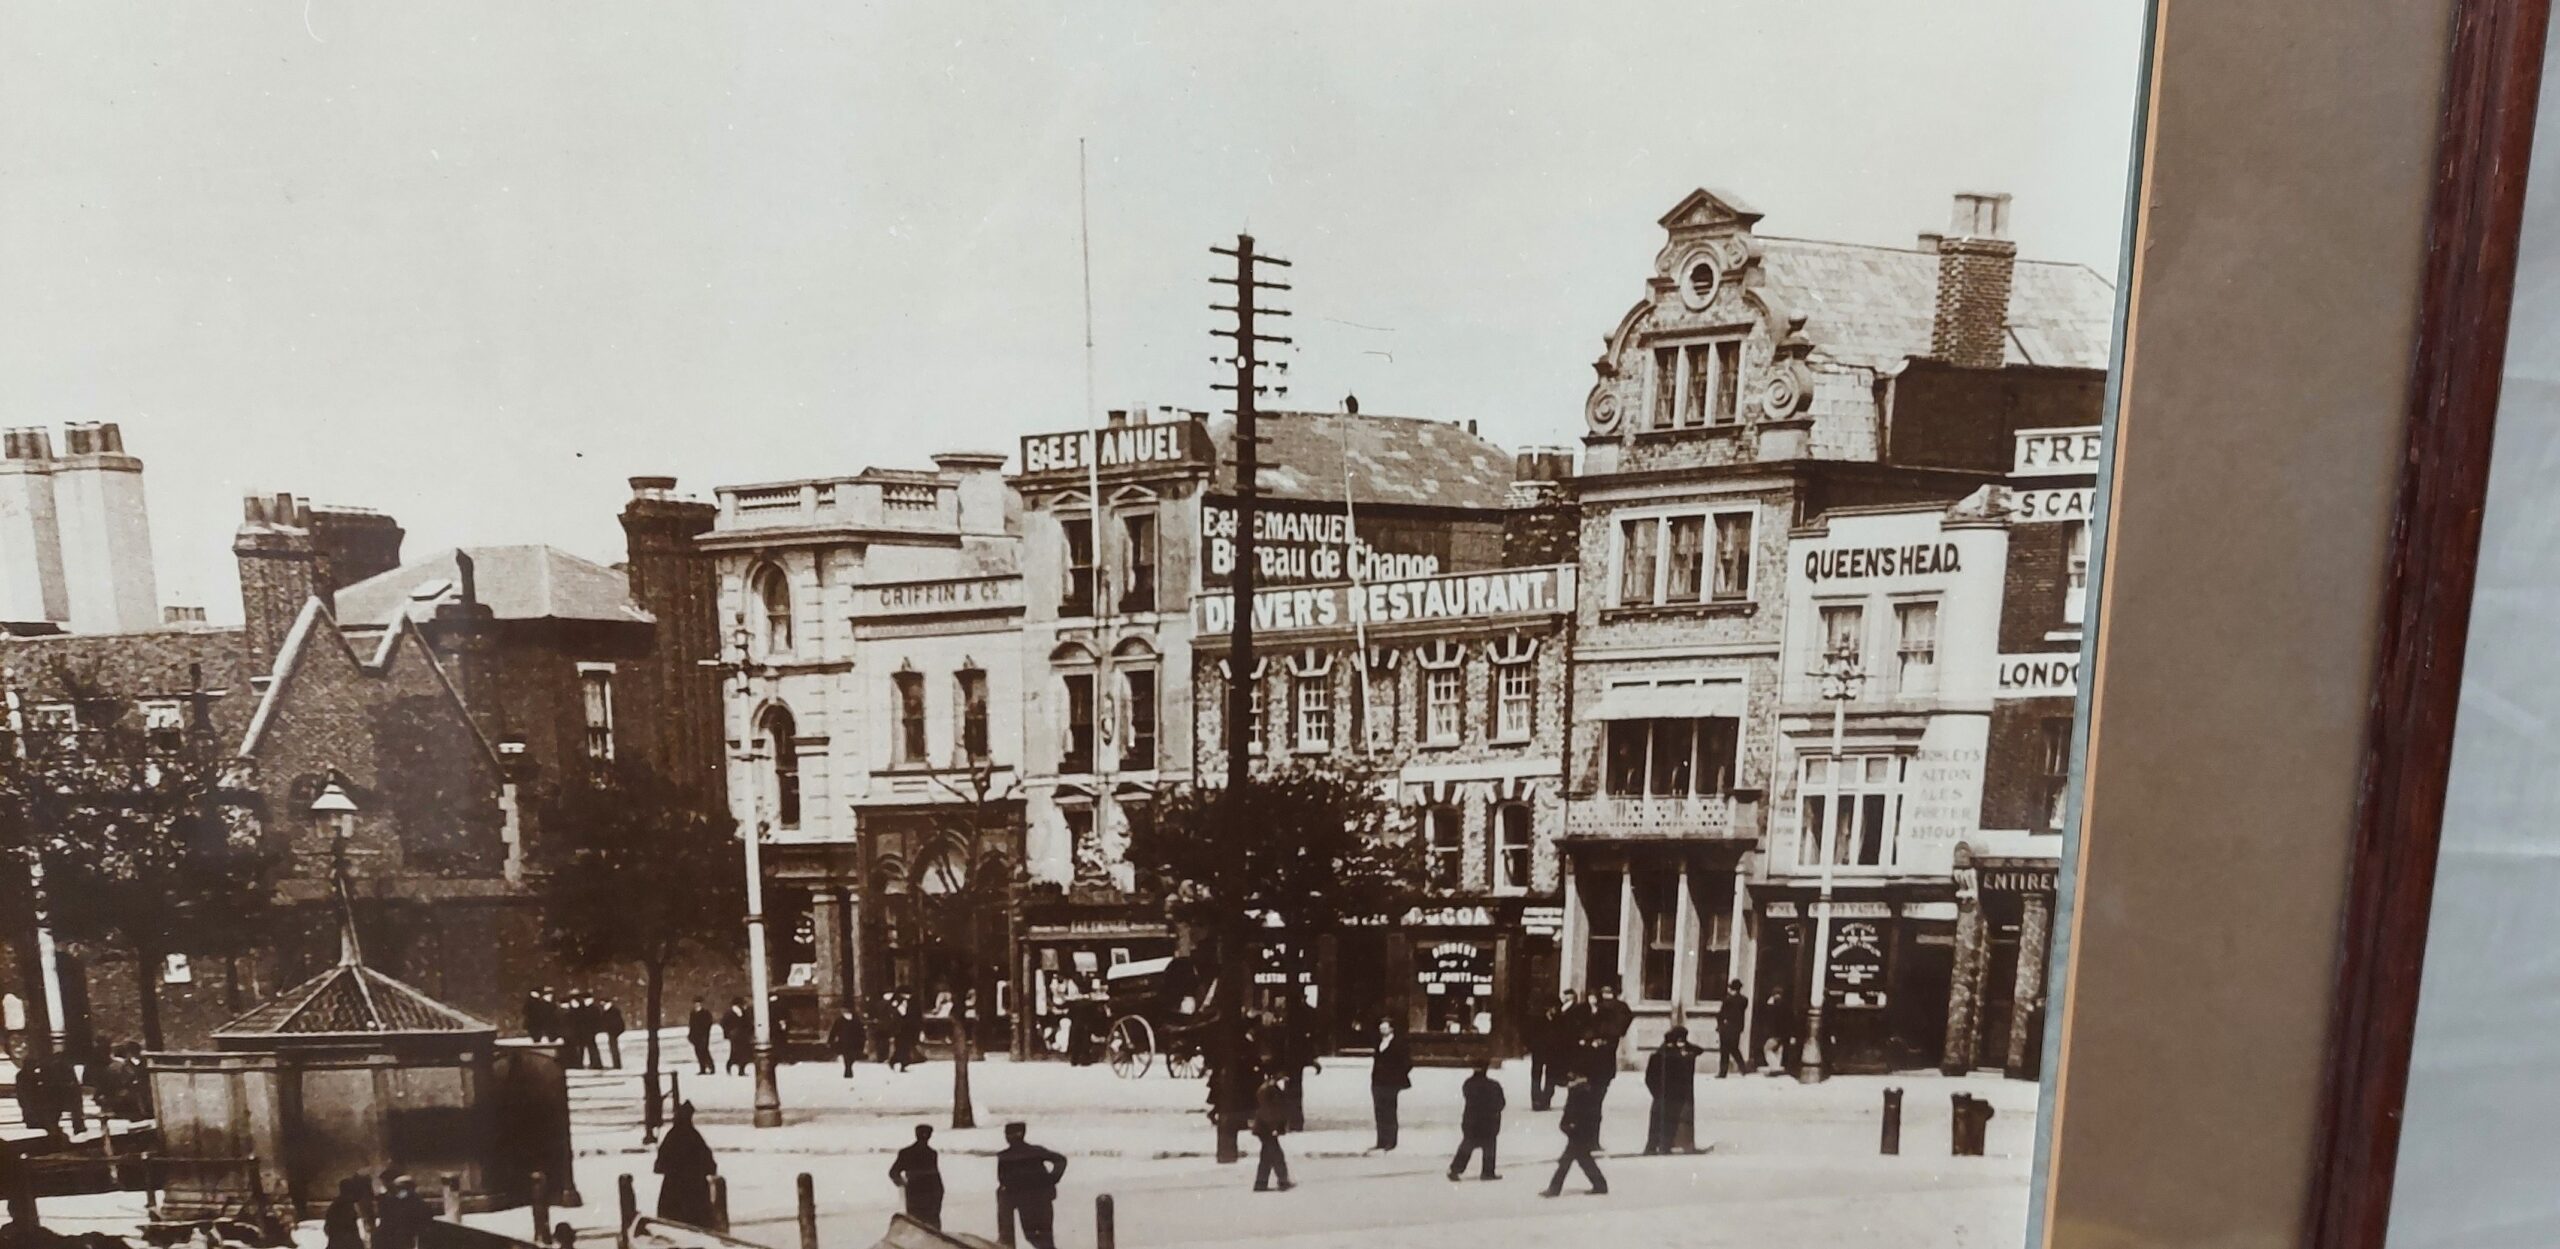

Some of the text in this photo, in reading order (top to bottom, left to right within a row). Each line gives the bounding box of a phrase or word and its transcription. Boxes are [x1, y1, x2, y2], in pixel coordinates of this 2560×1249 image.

[1311, 544, 1341, 579] de
[1805, 543, 1961, 583] QUEEN'S HEAD.
[1347, 571, 1555, 624] RESTAURANT.
